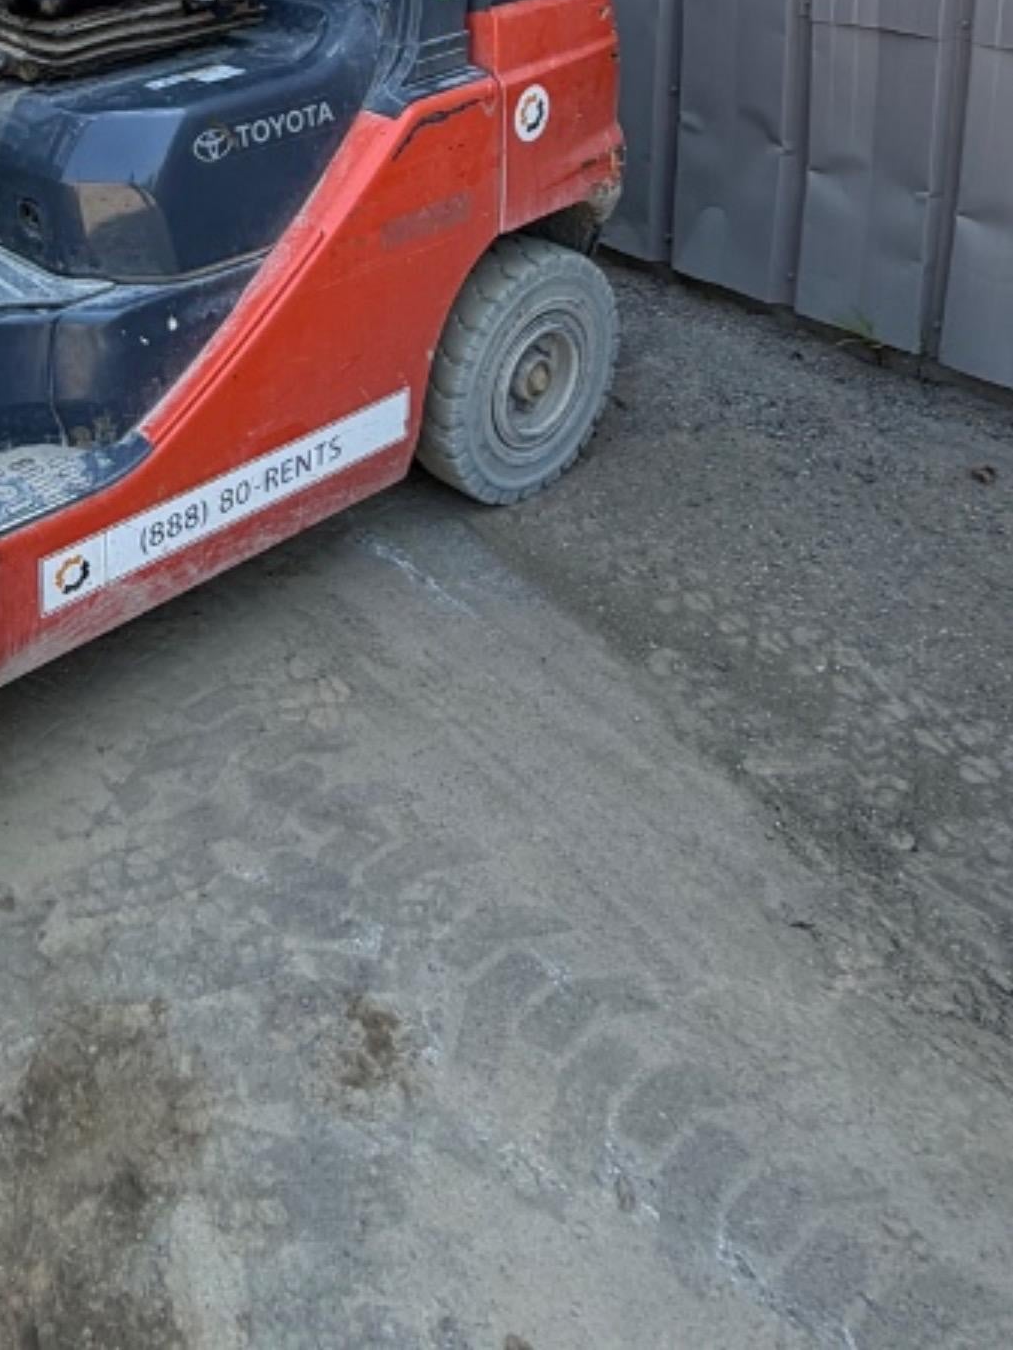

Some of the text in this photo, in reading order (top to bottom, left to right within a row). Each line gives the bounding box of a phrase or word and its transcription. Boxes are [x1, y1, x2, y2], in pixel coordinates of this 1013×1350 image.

[236, 101, 335, 148] TOYOTA
[139, 435, 342, 554] (888) 80-RENTS
